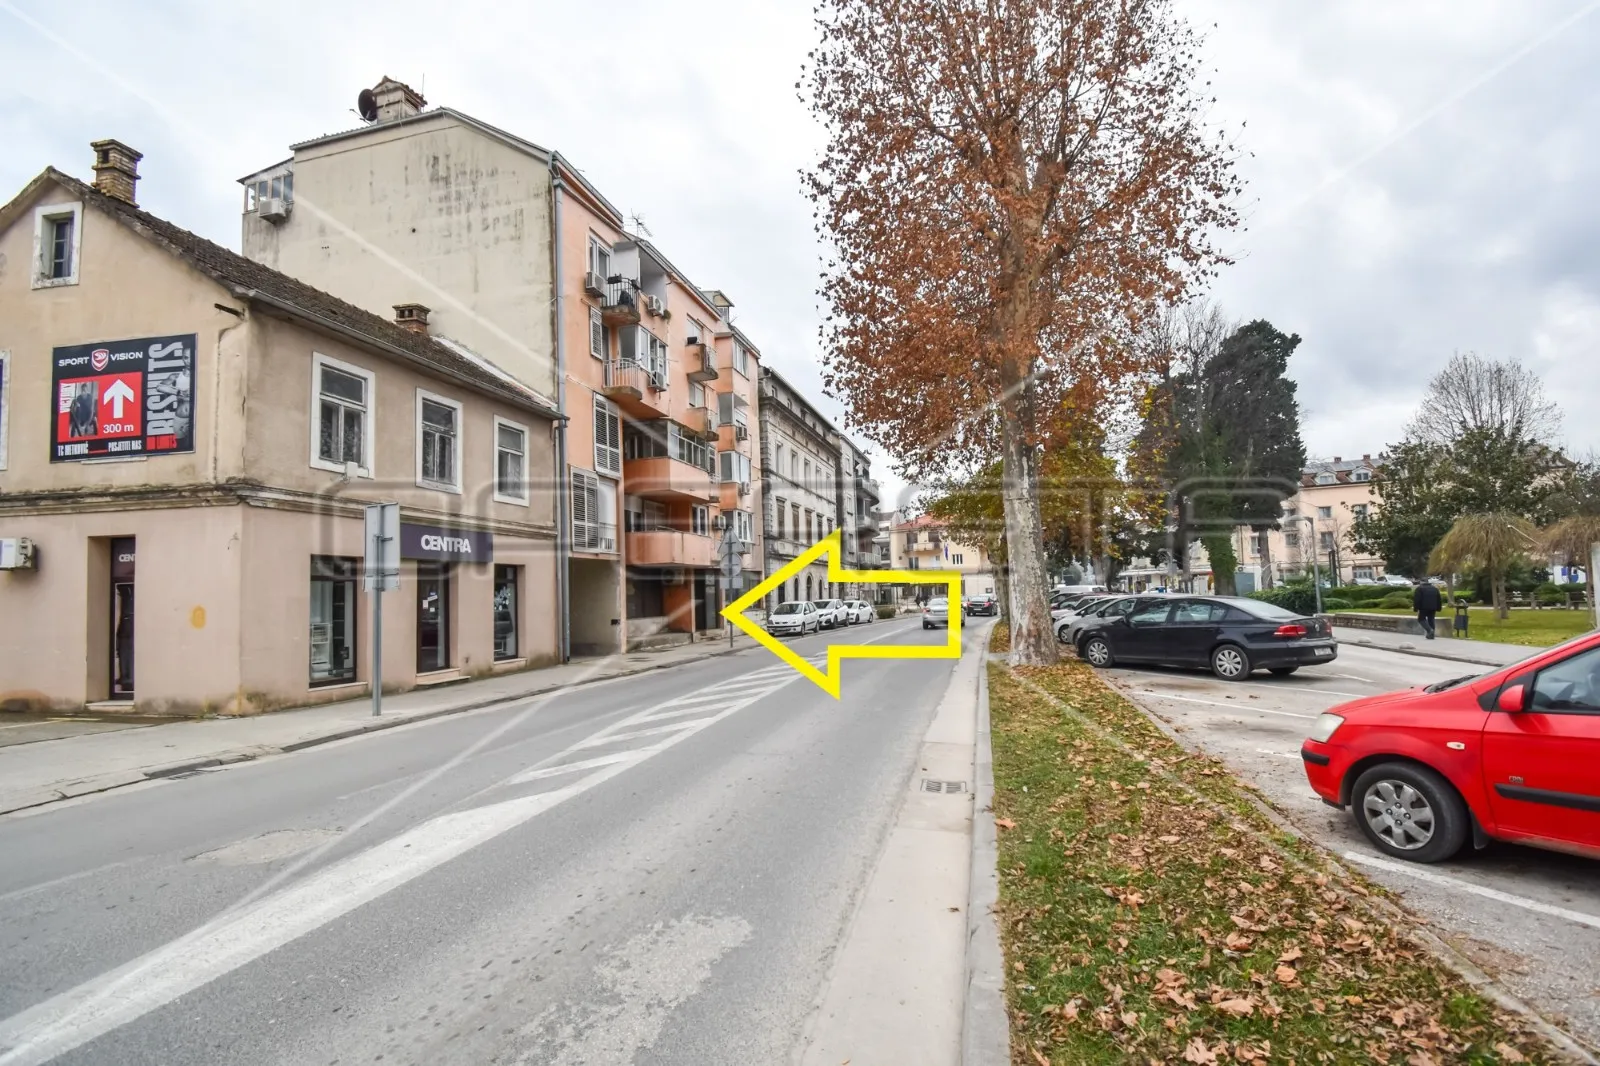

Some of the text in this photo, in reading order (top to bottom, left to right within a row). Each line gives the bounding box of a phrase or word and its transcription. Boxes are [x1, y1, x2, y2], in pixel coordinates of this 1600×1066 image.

[58, 351, 143, 367] SPORT VISION
[102, 423, 134, 434] 300 m
[420, 534, 472, 554] CENTRA
